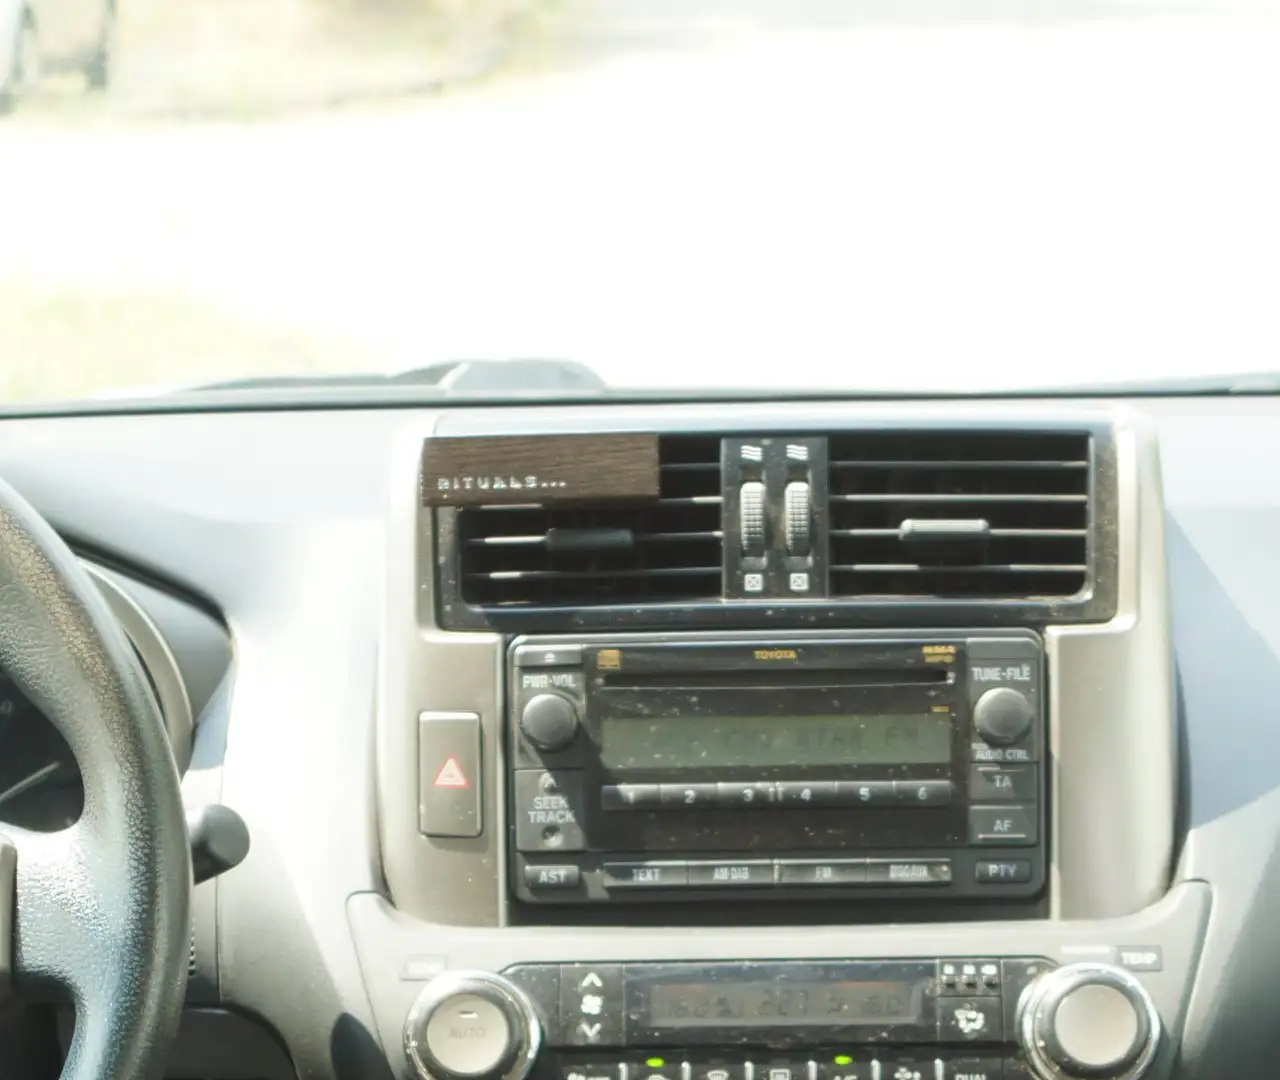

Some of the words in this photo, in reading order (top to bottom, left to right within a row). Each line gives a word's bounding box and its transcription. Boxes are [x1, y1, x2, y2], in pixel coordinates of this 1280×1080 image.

[994, 776, 1012, 788] TA
[627, 791, 635, 804] 1
[685, 790, 696, 803] 2
[743, 789, 754, 802] 3
[800, 788, 812, 801] 4
[859, 788, 870, 801] 5
[918, 788, 928, 800] 6
[534, 797, 568, 809] SEEK
[528, 811, 576, 824] TRACK
[993, 820, 1013, 832] AF
[539, 870, 567, 884] AST
[632, 868, 661, 881] TEXT
[988, 864, 1018, 877] PTY
[1121, 952, 1157, 965] TEMP
